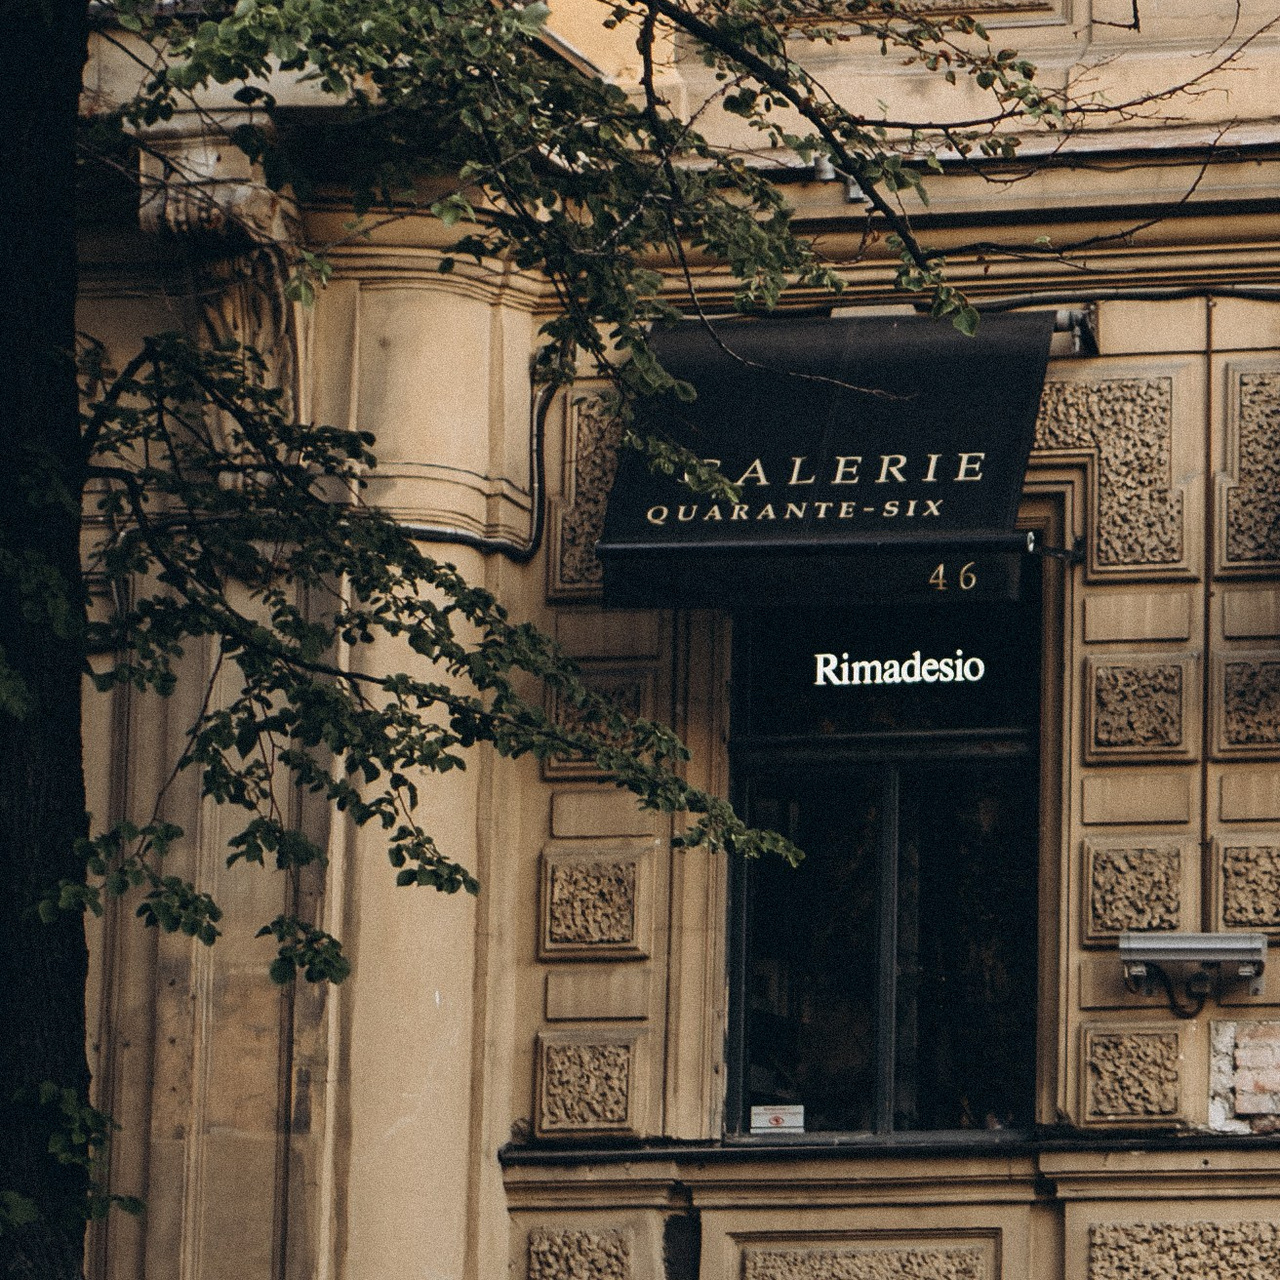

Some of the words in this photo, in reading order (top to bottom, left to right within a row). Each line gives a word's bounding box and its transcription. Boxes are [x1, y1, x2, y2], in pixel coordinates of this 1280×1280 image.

[683, 452, 986, 488] ALERIE
[646, 499, 944, 525] QUARANTE-SIX
[929, 562, 978, 590] 46
[813, 649, 986, 686] Rimadesio
